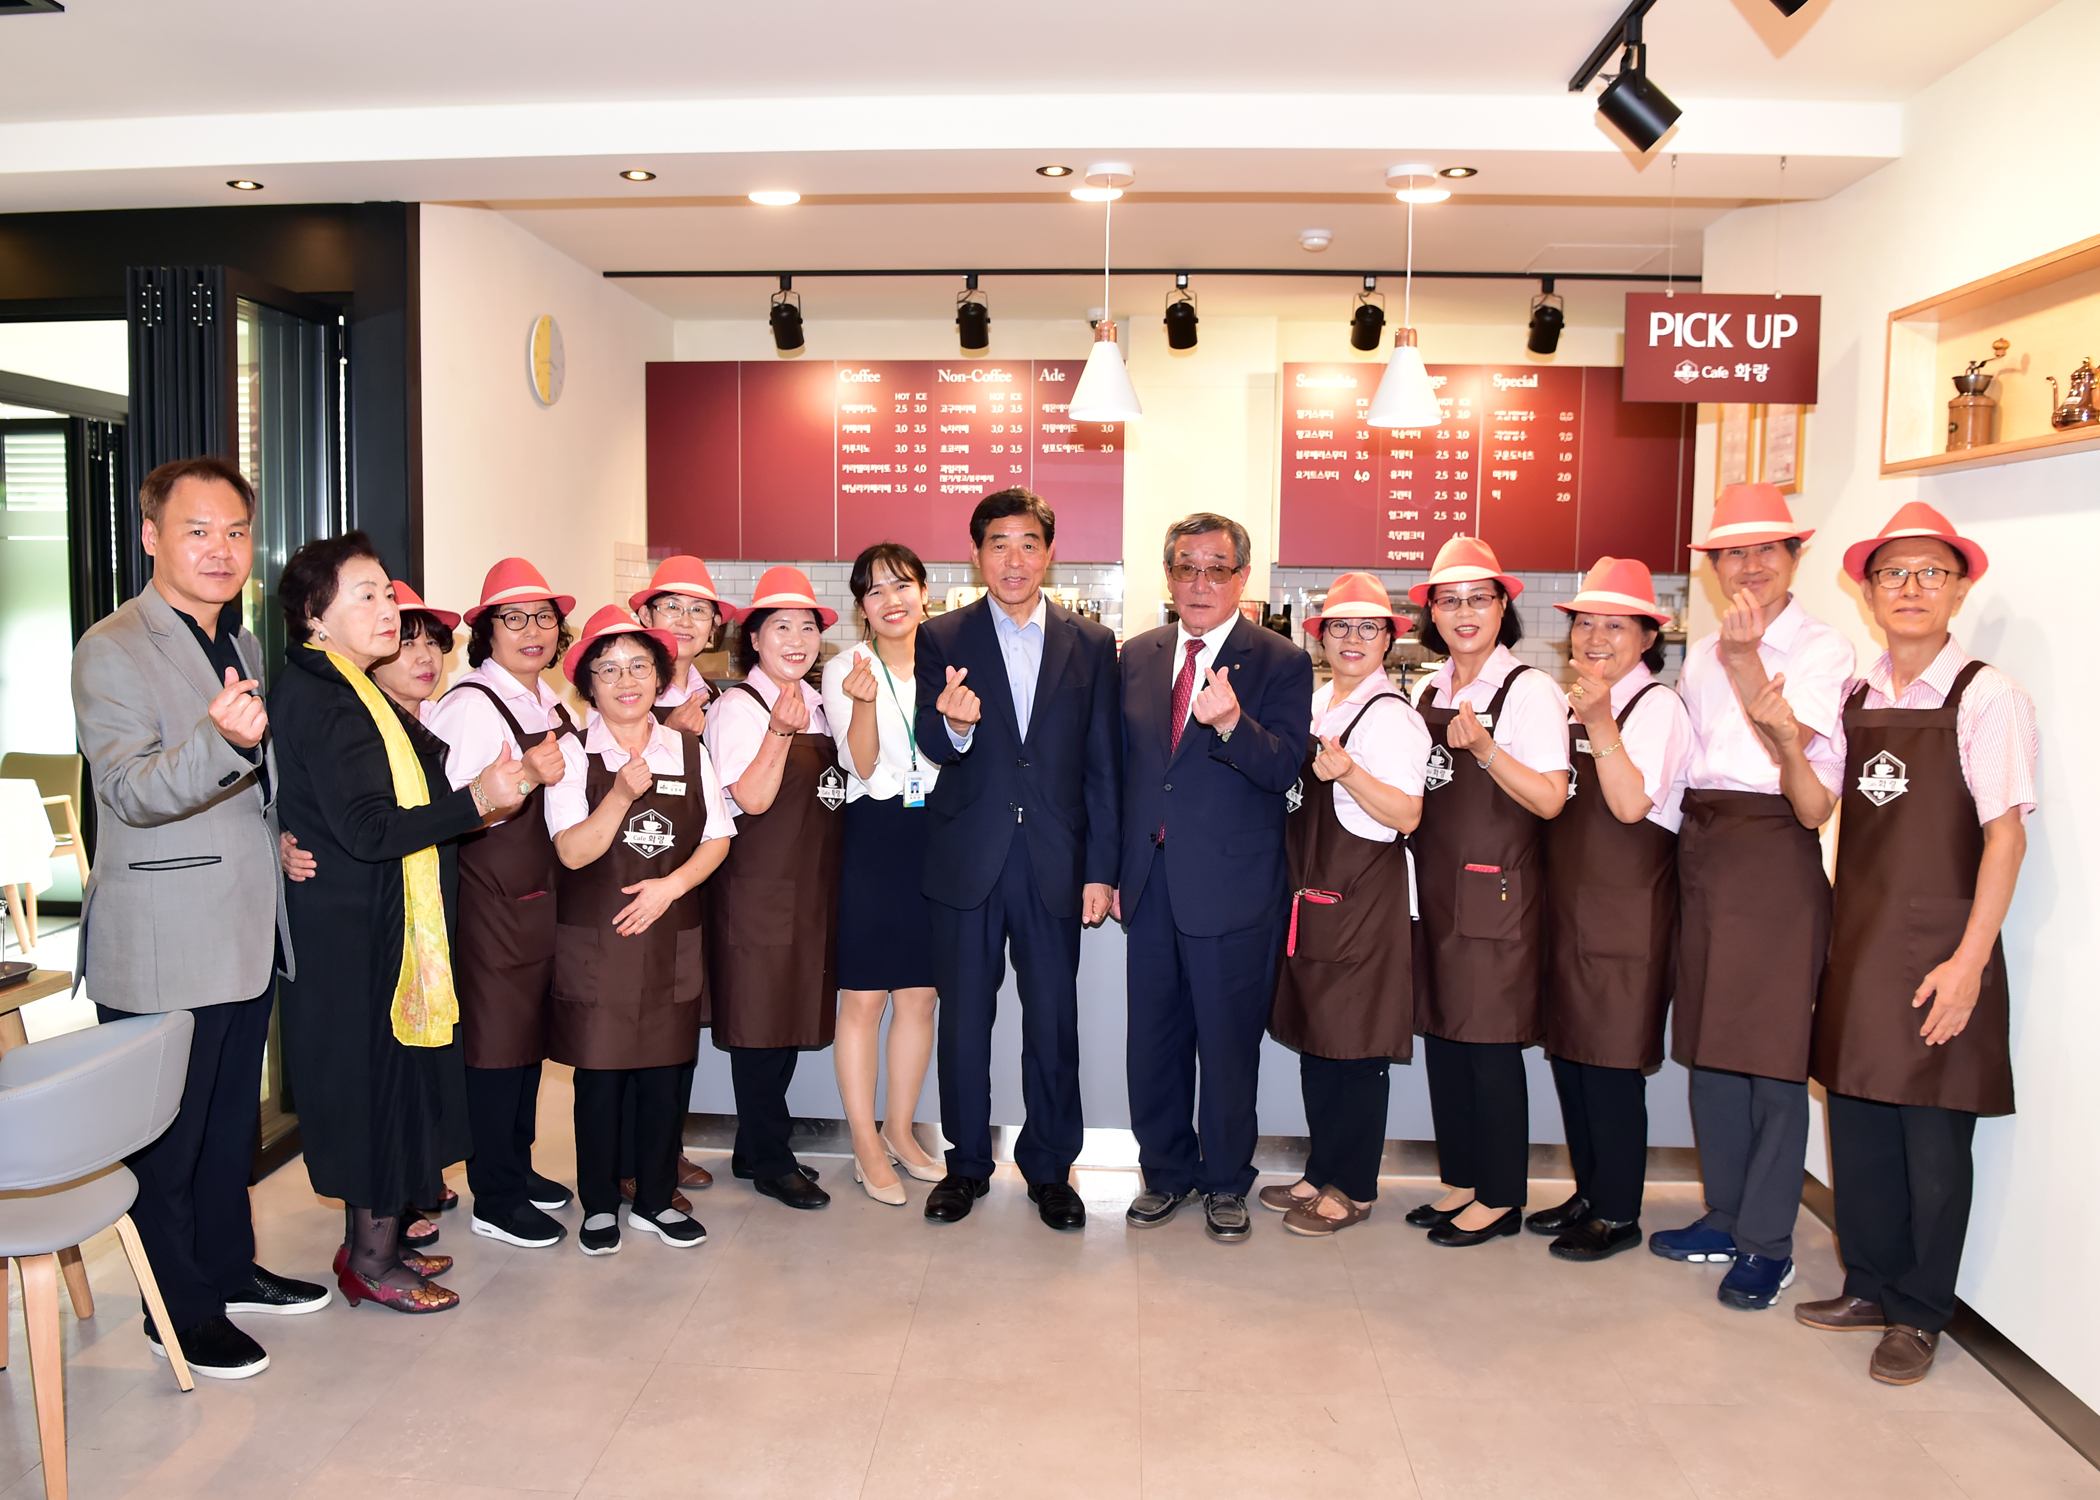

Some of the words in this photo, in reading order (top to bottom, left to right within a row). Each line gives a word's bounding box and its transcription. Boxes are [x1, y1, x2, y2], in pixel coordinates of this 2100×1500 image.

[1649, 311, 1734, 348] PICK
[1746, 313, 1798, 349] UP
[840, 369, 881, 382] Coffee
[938, 369, 1013, 383] Non-Coffee
[1039, 368, 1066, 382] Ade
[1701, 365, 1729, 379] Cafe
[1734, 363, 1770, 383] 화랑
[1296, 373, 1358, 388] Smoothie
[1492, 373, 1538, 391] Special
[1010, 393, 1022, 401] ICE
